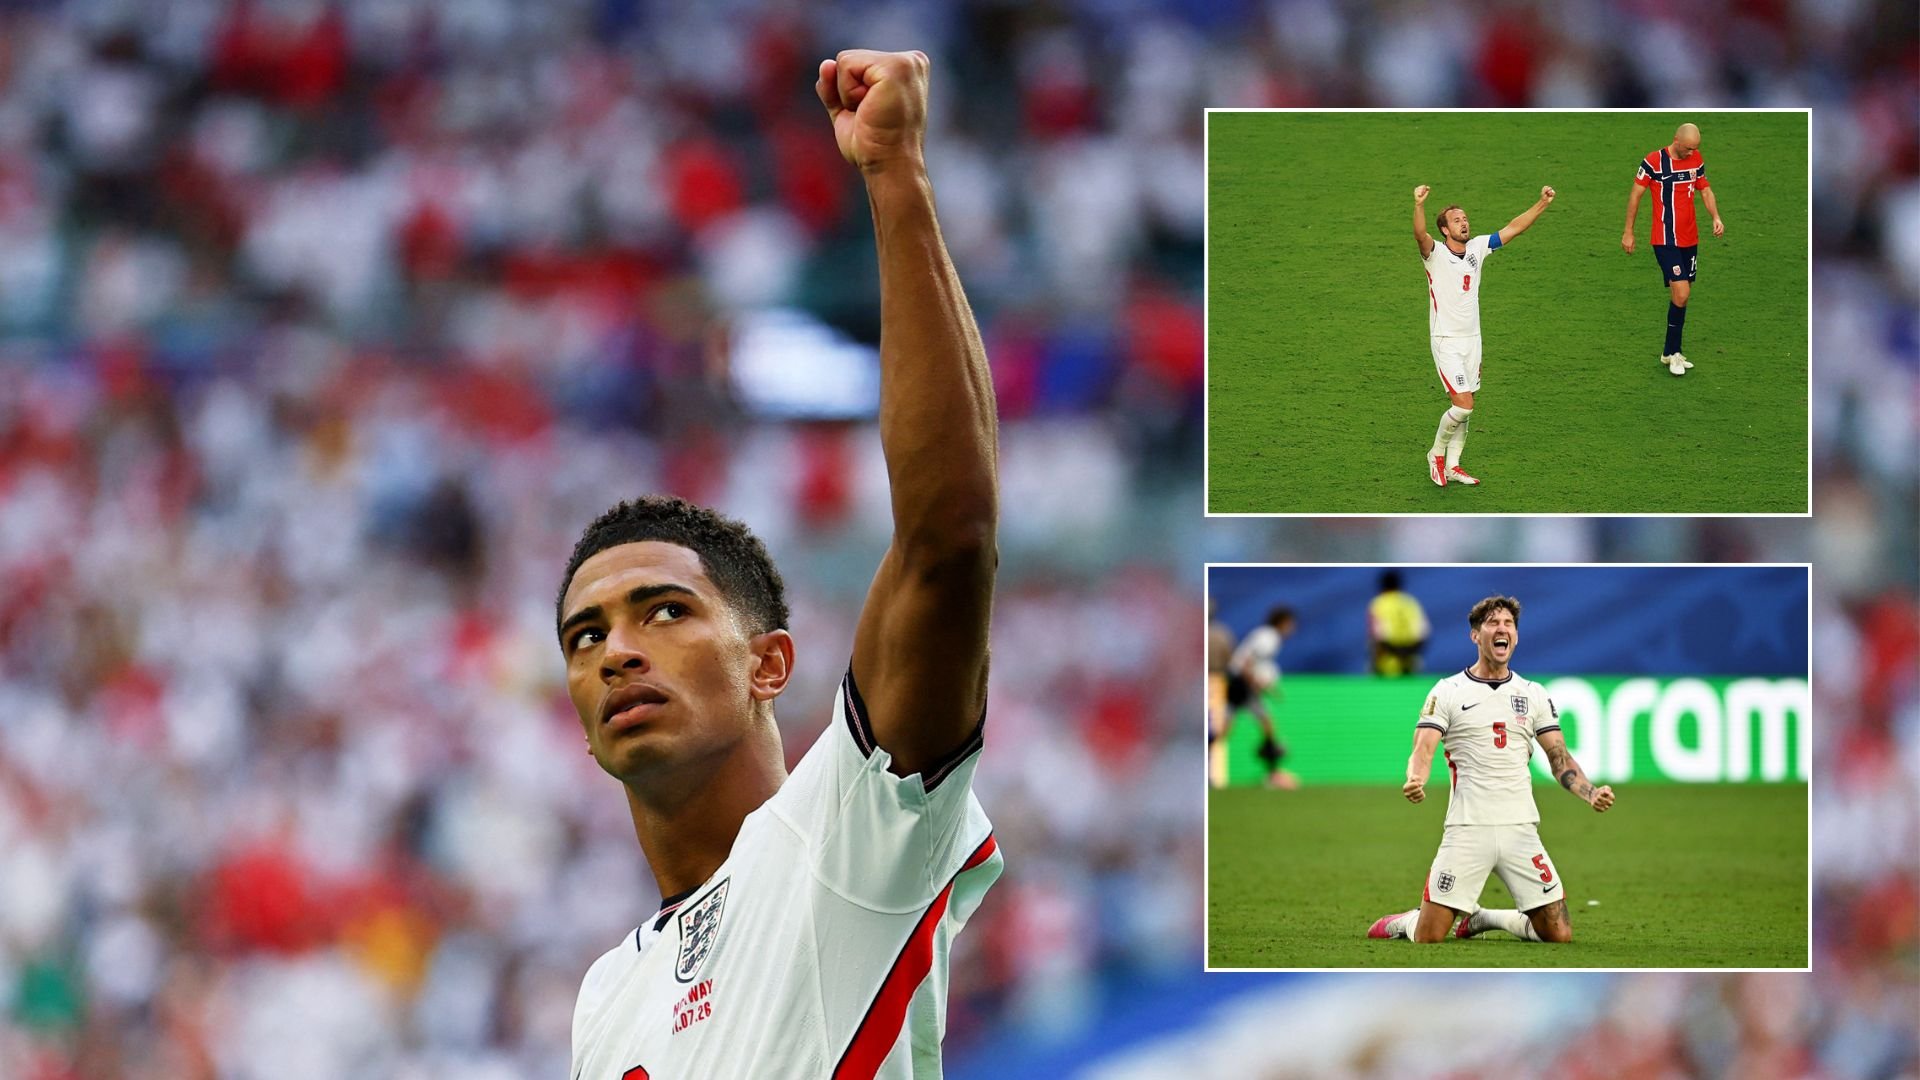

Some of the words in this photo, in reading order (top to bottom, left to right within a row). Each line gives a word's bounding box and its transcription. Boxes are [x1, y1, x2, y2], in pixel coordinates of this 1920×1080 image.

[1463, 275, 1471, 291] 9
[1493, 722, 1507, 748] 5
[1533, 676, 1808, 783] aram
[1532, 854, 1552, 883] 5
[673, 979, 713, 1018] NWAY
